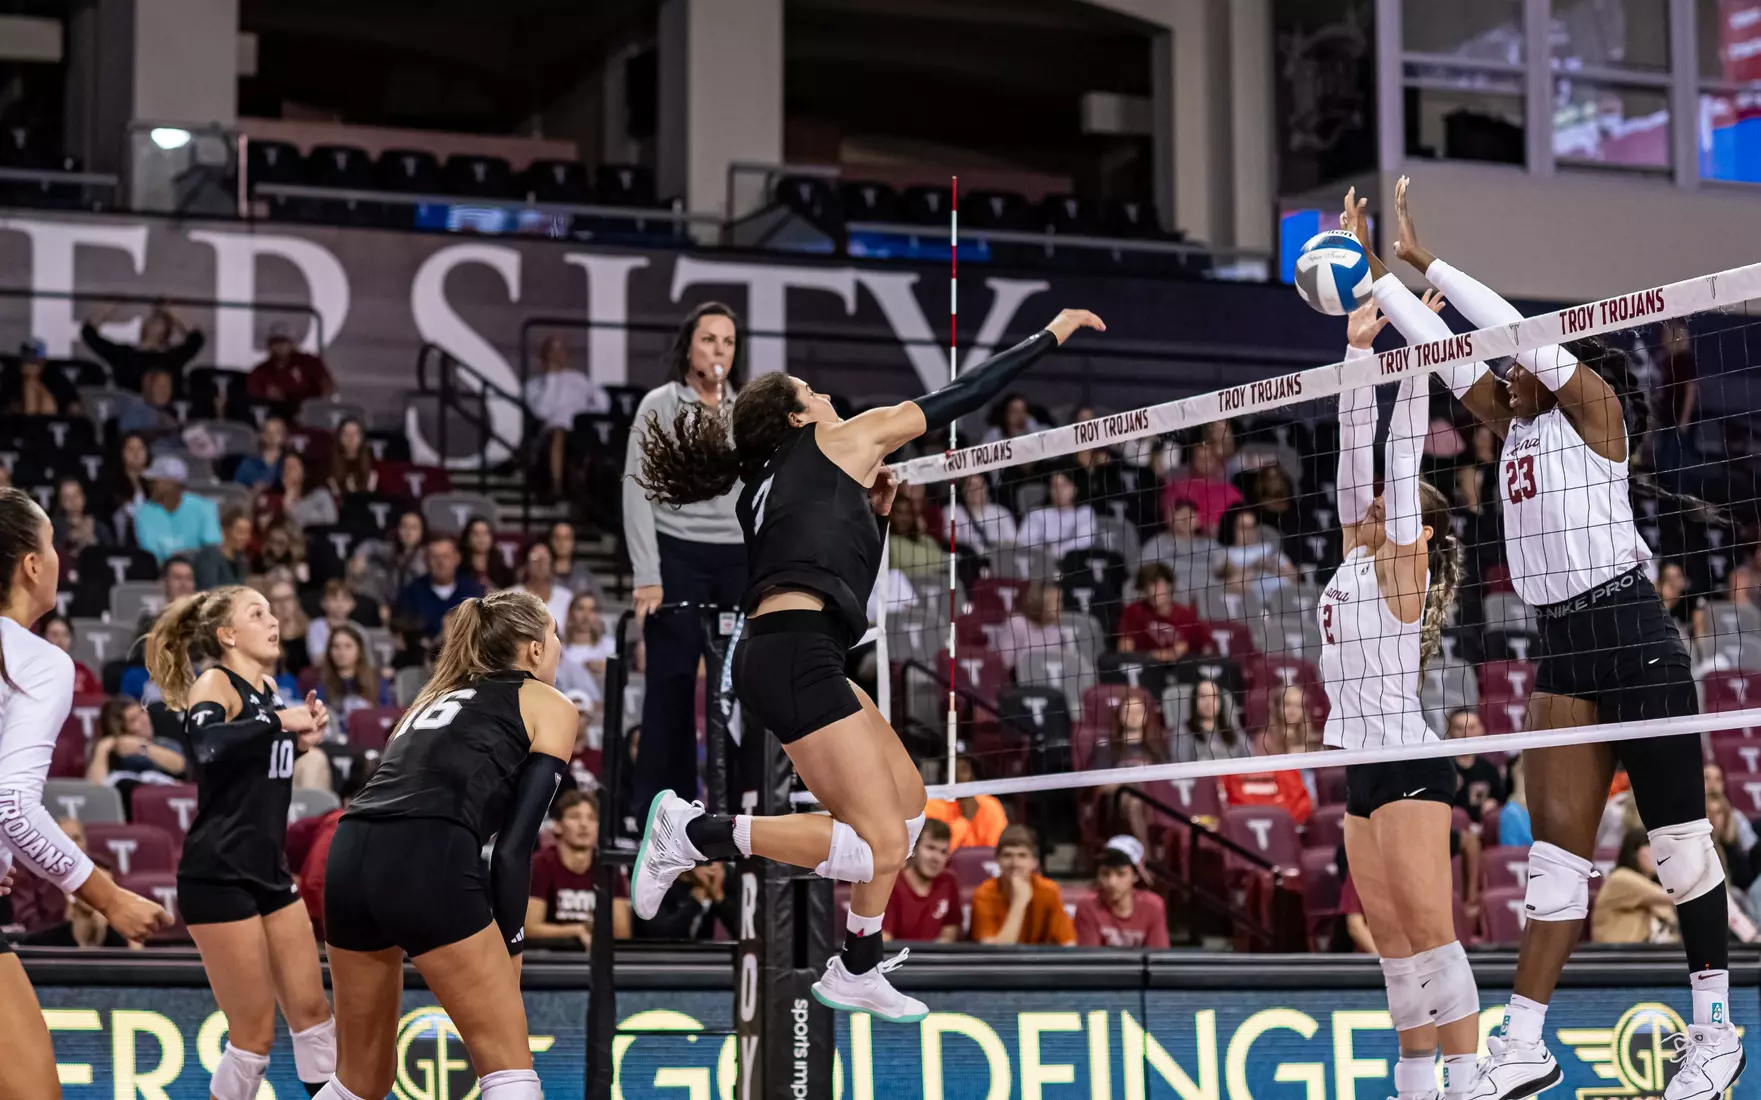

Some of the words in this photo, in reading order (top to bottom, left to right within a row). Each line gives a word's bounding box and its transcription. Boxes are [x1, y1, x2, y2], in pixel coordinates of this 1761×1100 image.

[1559, 304, 1595, 335] TROY
[1600, 288, 1665, 325] TROJANS
[1378, 346, 1411, 376] TROY
[1414, 333, 1473, 368] TROJANS
[1217, 385, 1247, 412] TROY
[1250, 373, 1302, 406] TROJANS
[1074, 418, 1102, 445] TROY
[1103, 409, 1149, 438] TROJANS
[970, 440, 1012, 467] TROJANS
[1506, 454, 1538, 505] 23
[1546, 595, 1588, 619] NIKE
[1591, 574, 1634, 604] PRO
[1323, 603, 1336, 646] 2
[268, 739, 294, 779] 10
[0, 788, 75, 877] TROJANS
[790, 998, 811, 1058] sports
[789, 1060, 809, 1100] imp
